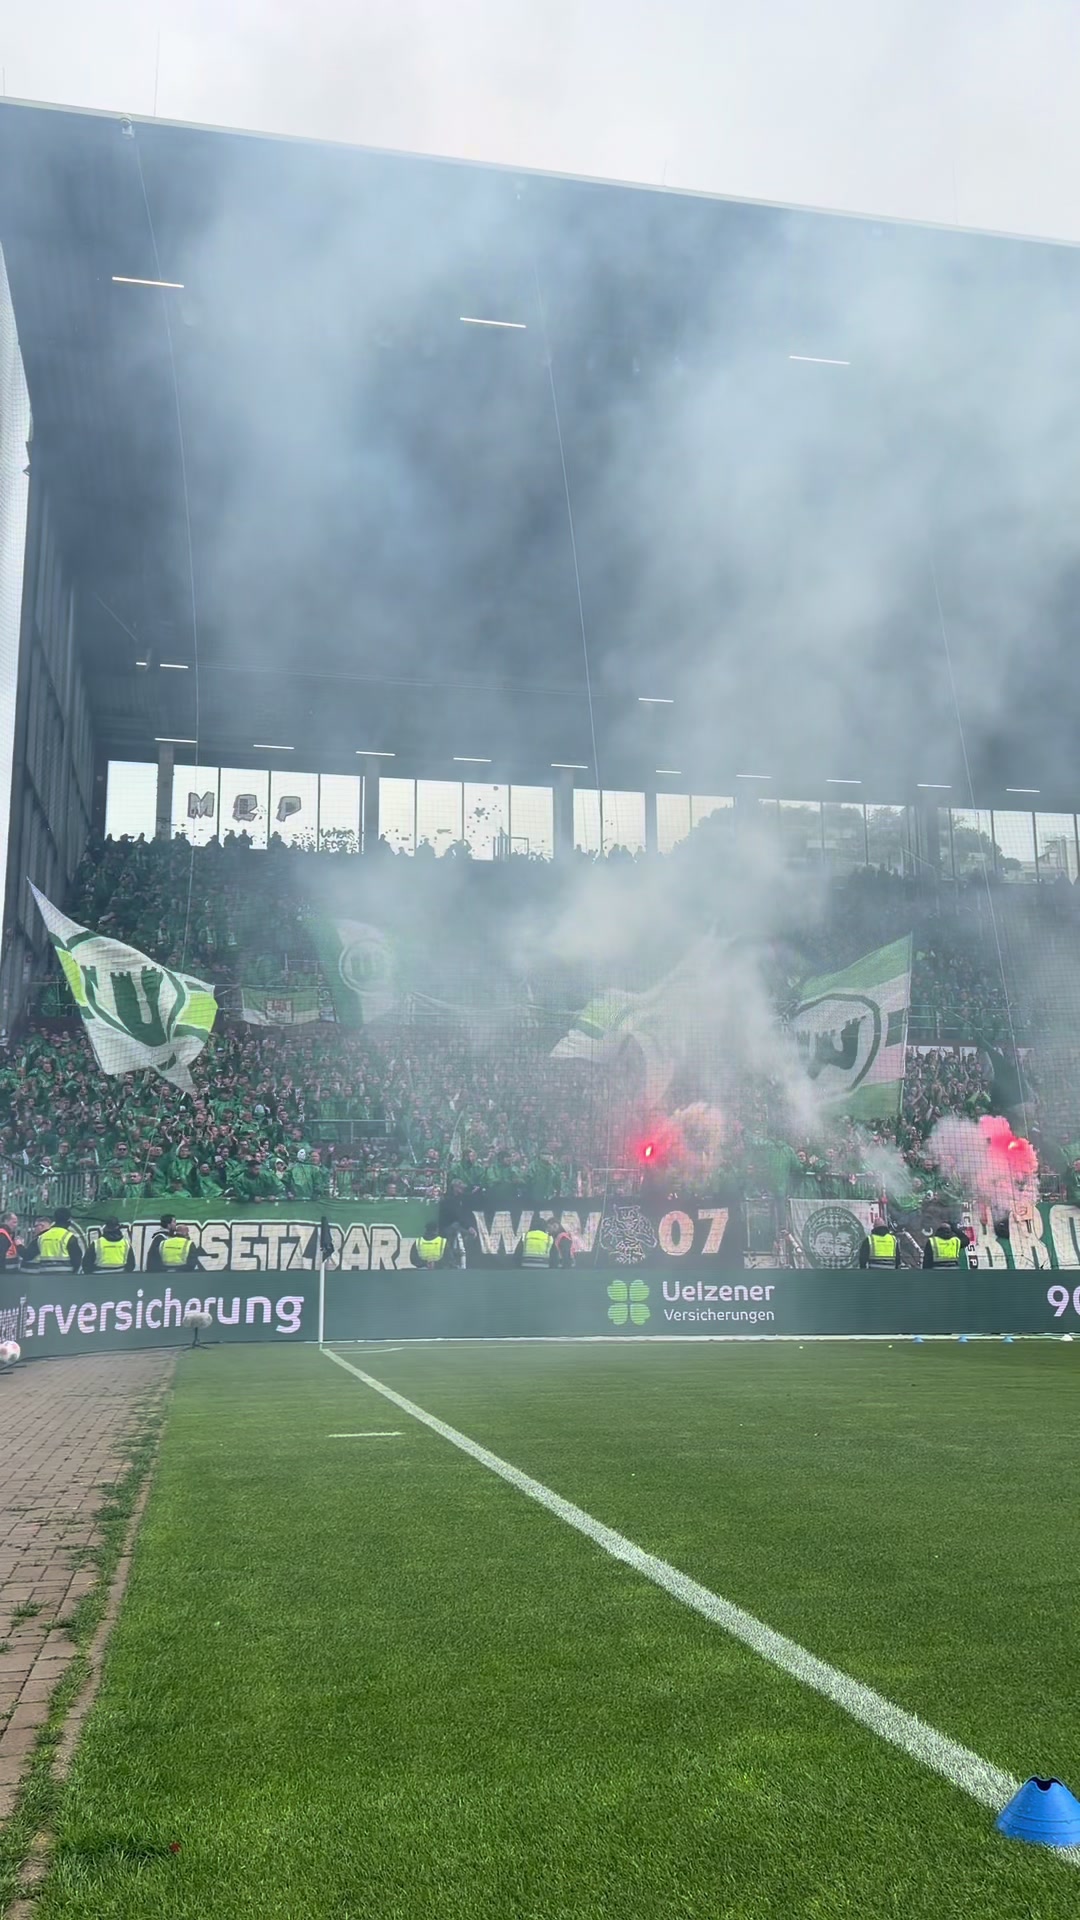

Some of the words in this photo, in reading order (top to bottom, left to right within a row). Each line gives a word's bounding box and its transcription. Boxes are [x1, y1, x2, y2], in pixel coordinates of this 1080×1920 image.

[658, 1207, 729, 1256] 07
[662, 1280, 775, 1302] Uelzener
[20, 1287, 304, 1337] erversicherung
[663, 1308, 775, 1324] Versicherungen
